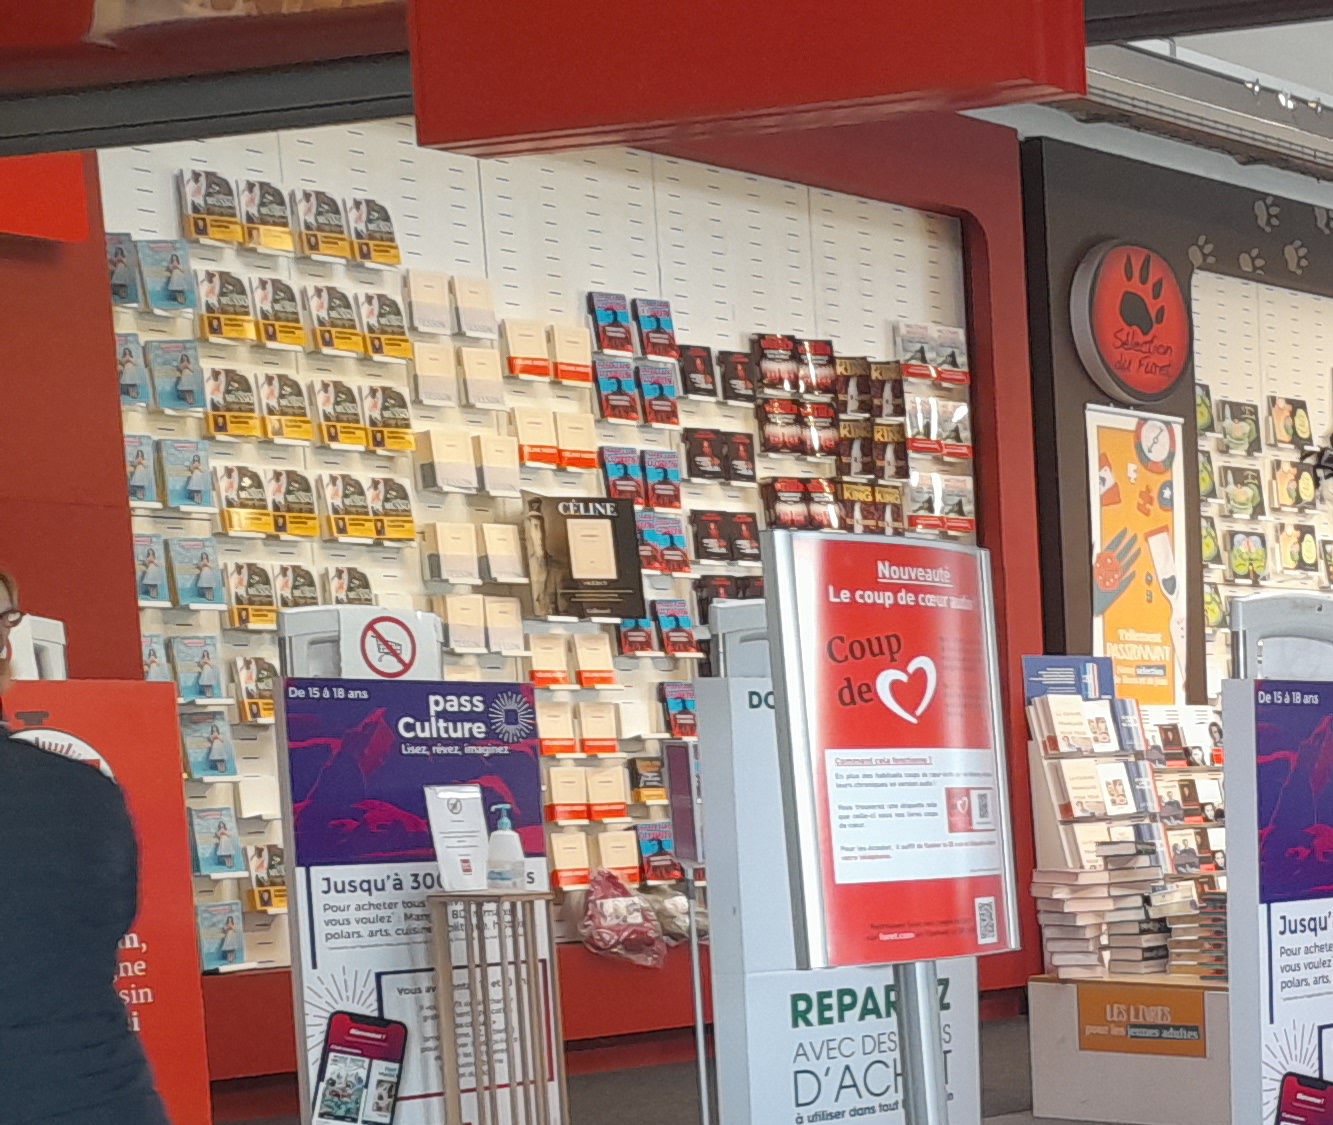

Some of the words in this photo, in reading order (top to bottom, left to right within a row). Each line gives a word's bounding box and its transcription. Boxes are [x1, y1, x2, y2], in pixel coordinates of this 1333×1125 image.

[829, 585, 850, 602] Le
[855, 590, 894, 607] coup
[898, 589, 916, 605] de
[827, 632, 903, 664] Coup
[288, 687, 305, 698] De
[308, 687, 320, 698] 15
[332, 688, 344, 698] 18
[838, 677, 873, 707] de
[1258, 691, 1271, 703] De
[1273, 691, 1282, 704] 15
[428, 694, 484, 716] pass
[398, 717, 487, 738] Culture
[321, 873, 404, 896] Jusqu'à
[1279, 945, 1302, 957] Pour
[790, 978, 950, 1029] REPARZ
[1106, 1003, 1127, 1022] LES
[1130, 1004, 1171, 1023] LIVRES
[793, 1037, 855, 1063] AVEC
[862, 1032, 897, 1056] DES
[795, 1112, 803, 1125] à
[807, 1106, 846, 1124] utiliser
[849, 1102, 876, 1117] dans
